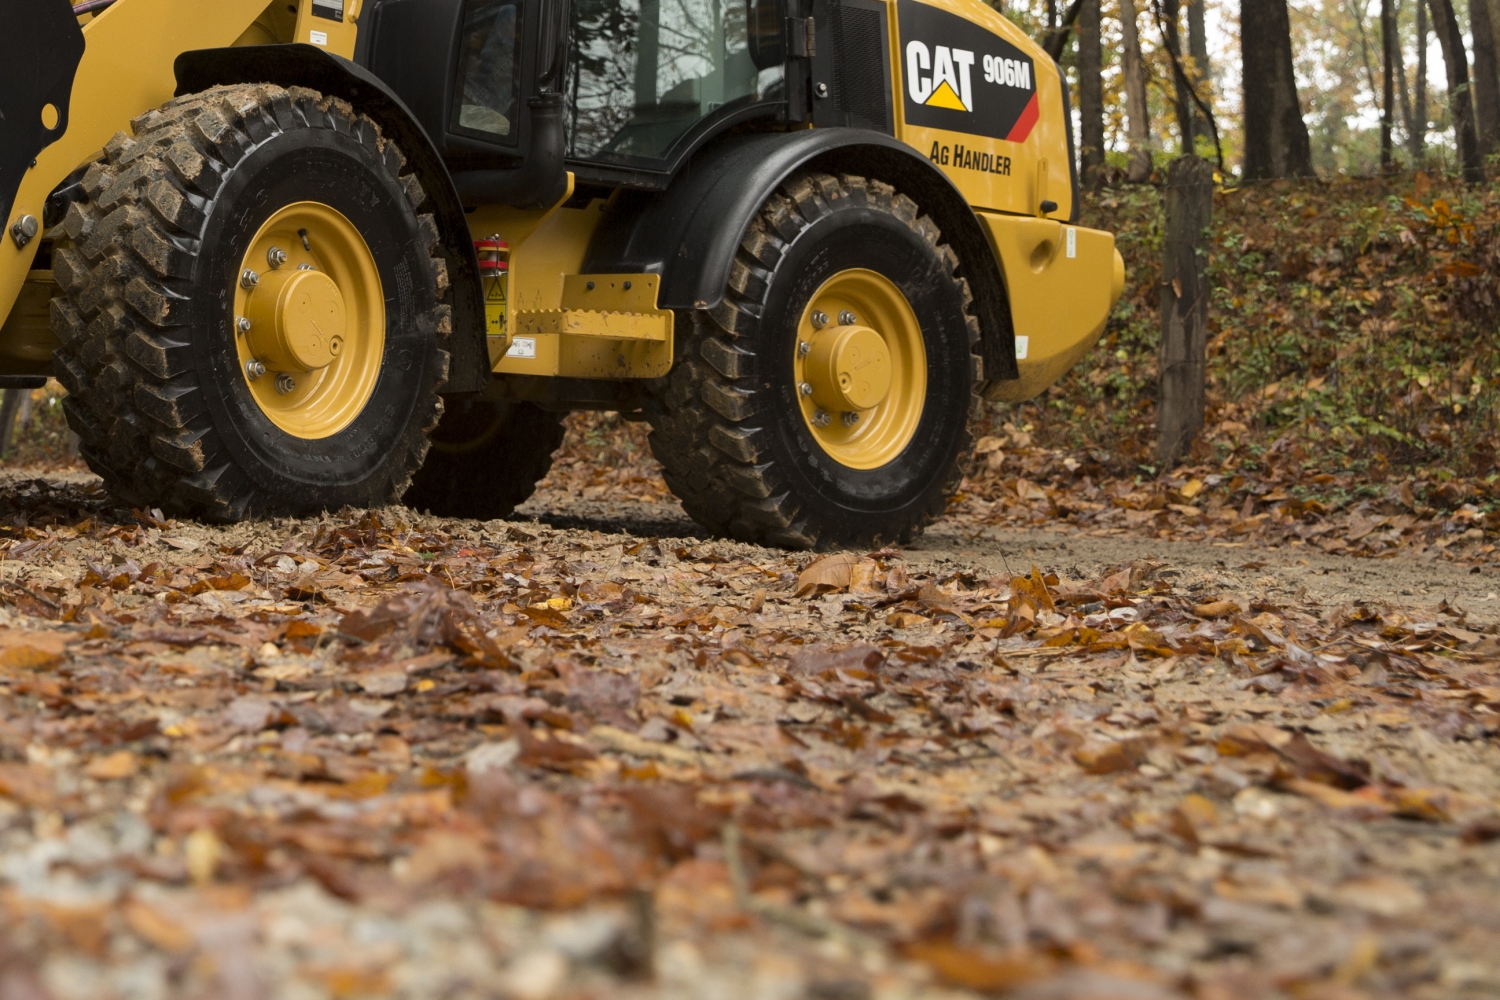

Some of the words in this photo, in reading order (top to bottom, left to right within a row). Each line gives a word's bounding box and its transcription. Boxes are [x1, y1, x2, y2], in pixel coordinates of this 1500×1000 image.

[906, 40, 975, 113] CAT
[983, 54, 1031, 90] 906M
[953, 144, 1011, 177] HANDLER
